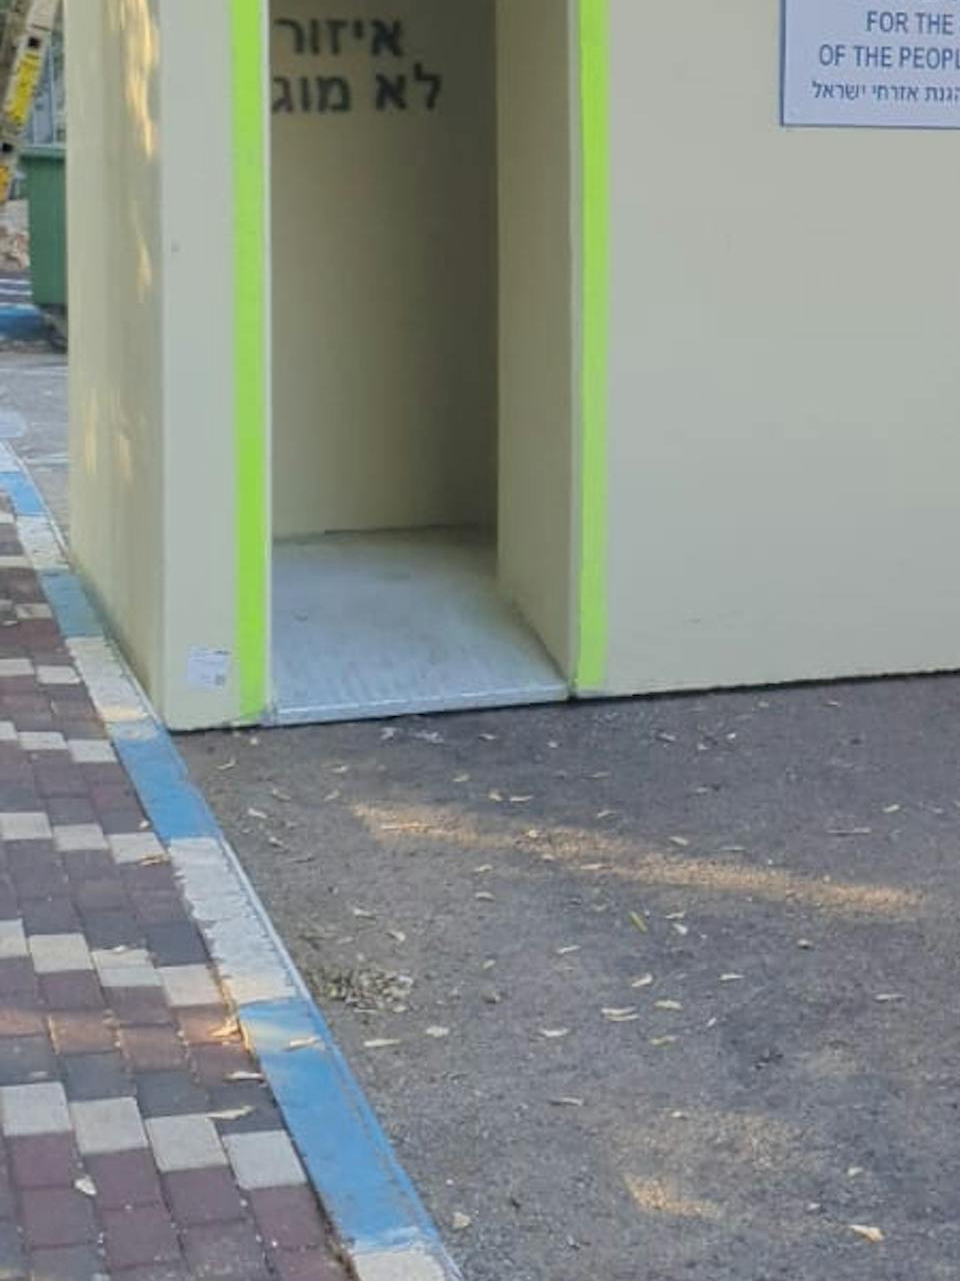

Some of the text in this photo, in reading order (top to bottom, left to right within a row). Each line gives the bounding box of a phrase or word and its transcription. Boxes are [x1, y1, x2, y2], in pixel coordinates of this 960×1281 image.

[866, 10, 909, 34] FOR
[915, 12, 954, 37] THE
[273, 17, 404, 57] איזור
[819, 43, 846, 67] OF
[853, 45, 893, 68] THE
[271, 62, 442, 113] לא מוג
[811, 79, 866, 101] ישראל
[872, 84, 919, 102] אזרחי
